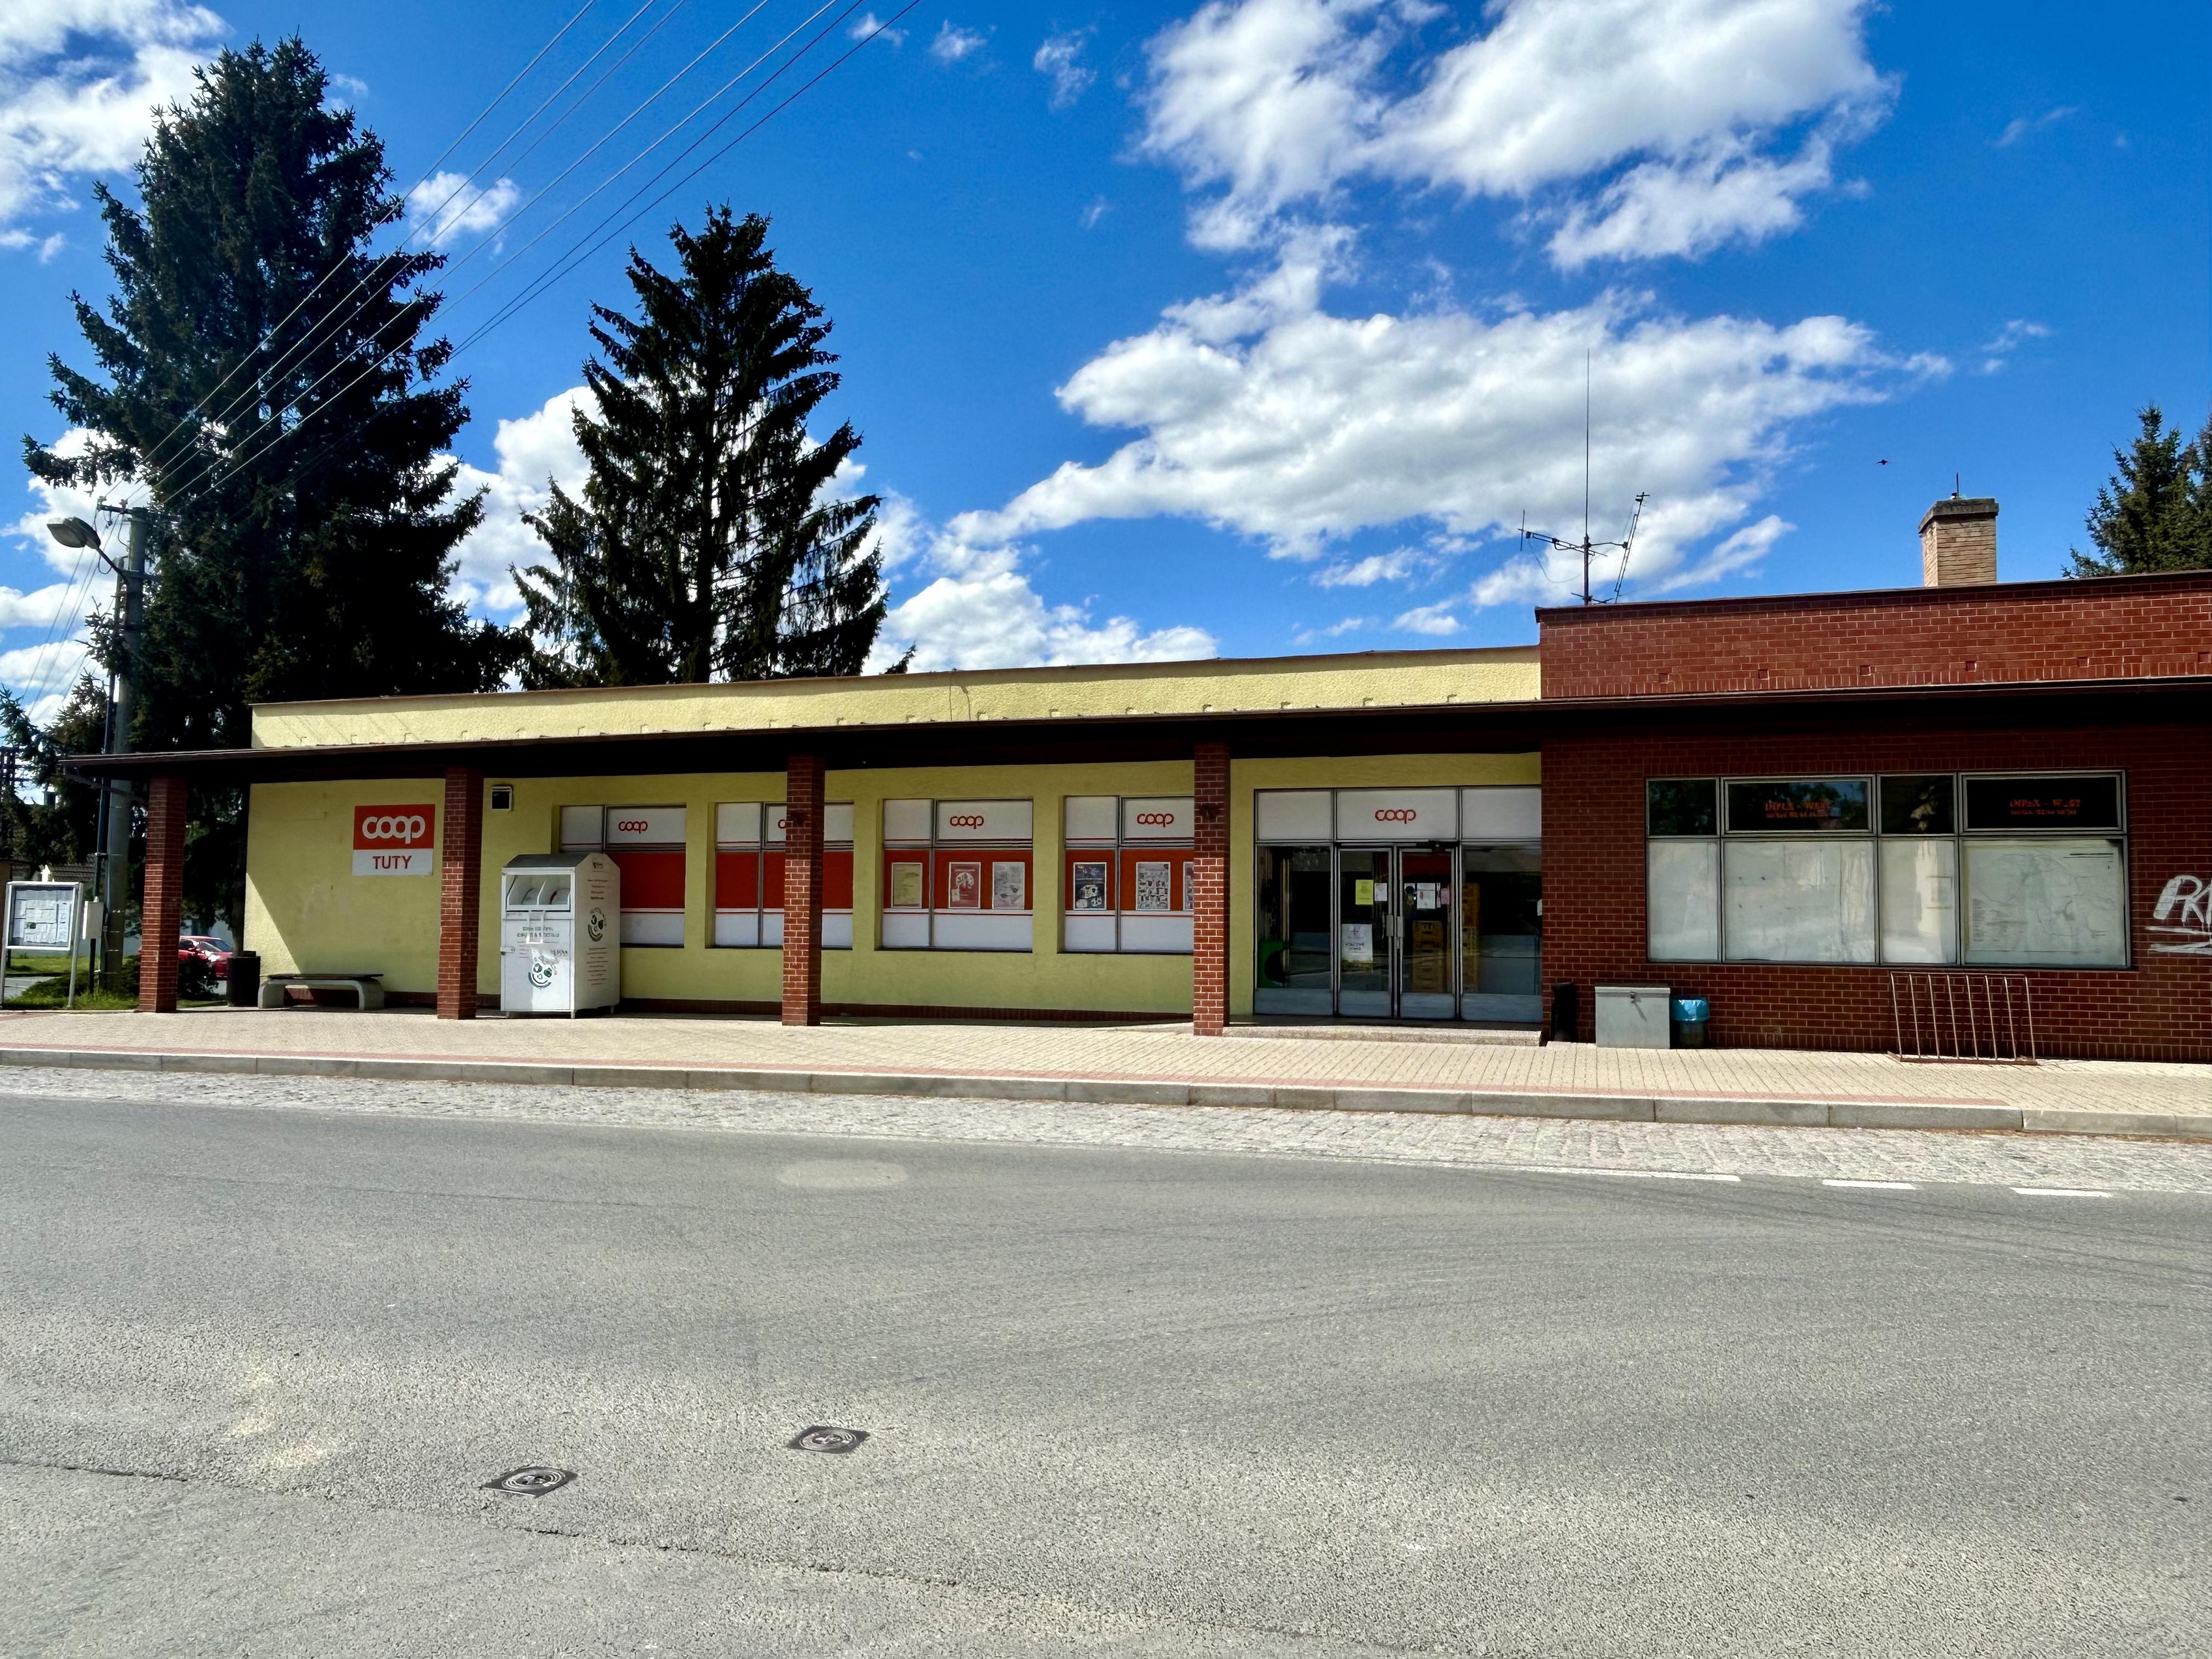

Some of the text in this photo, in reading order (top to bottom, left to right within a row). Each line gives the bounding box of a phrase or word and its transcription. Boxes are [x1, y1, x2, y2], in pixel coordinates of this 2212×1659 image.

[950, 815, 984, 830] coop
[1137, 813, 1174, 827] coop
[1375, 808, 1416, 824] coop
[362, 815, 425, 844] coop
[618, 821, 648, 834] coop
[372, 855, 412, 869] TUTY
